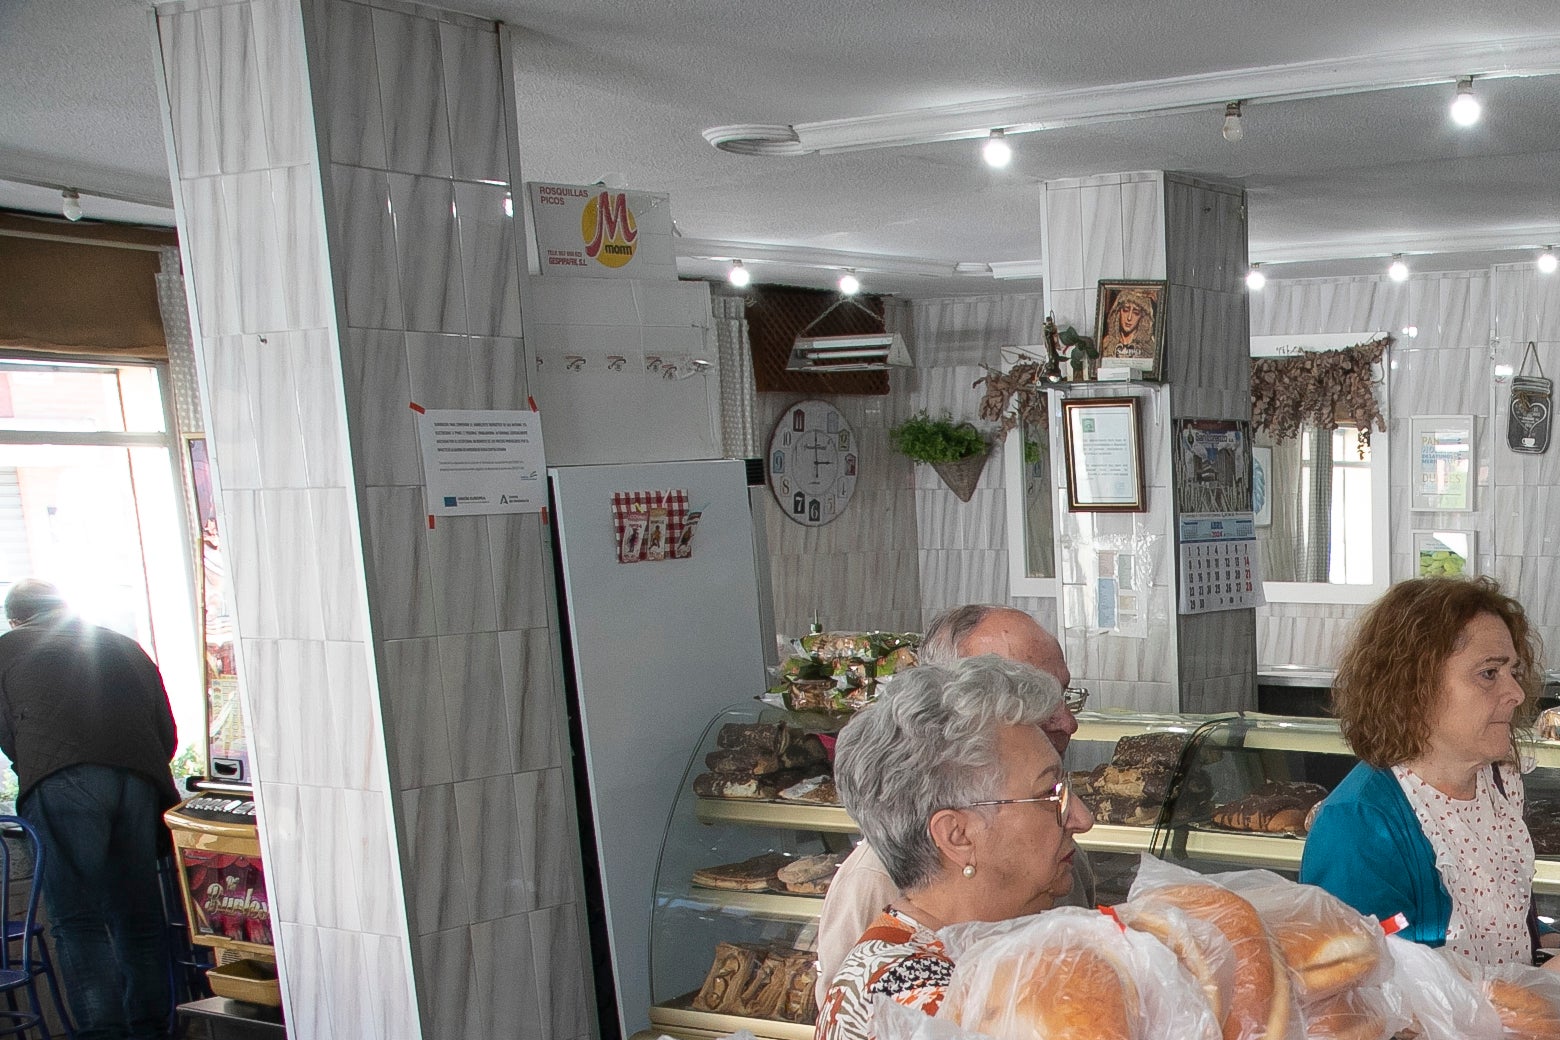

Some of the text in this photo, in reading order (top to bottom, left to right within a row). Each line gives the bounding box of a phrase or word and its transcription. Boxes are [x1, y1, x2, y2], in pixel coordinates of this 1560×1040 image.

[540, 187, 588, 197] ROSQUILLAS
[541, 196, 564, 205] PICOS
[585, 191, 637, 257] M
[796, 497, 802, 512] 7
[811, 504, 818, 519] 6
